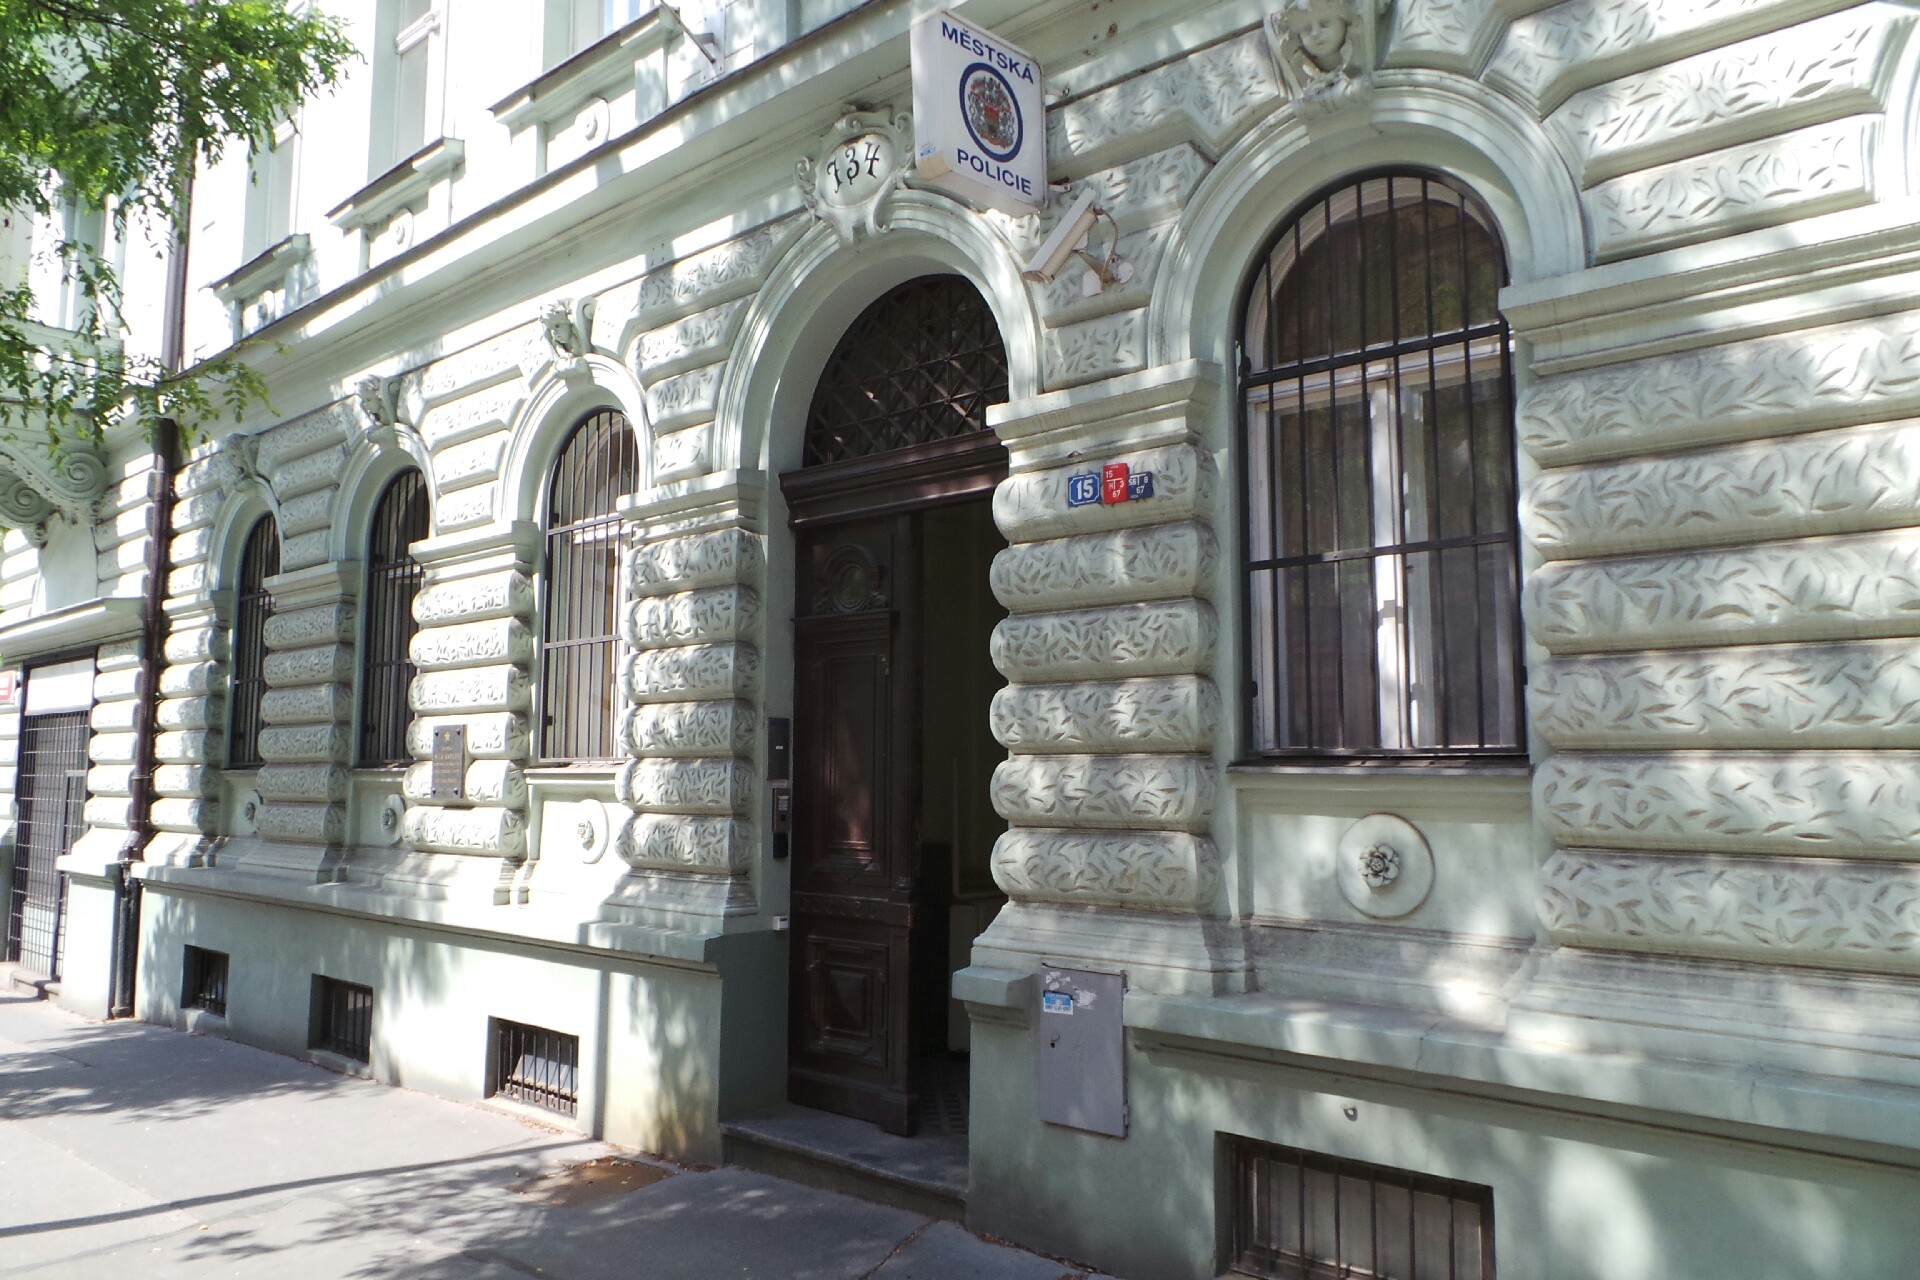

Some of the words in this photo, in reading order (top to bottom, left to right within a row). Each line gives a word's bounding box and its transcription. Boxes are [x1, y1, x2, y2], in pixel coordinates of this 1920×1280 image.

[942, 21, 1034, 84] MĚSTSKÁ
[826, 141, 881, 194] 734
[957, 148, 1032, 196] POLICIE
[1077, 478, 1094, 500] 15
[1105, 470, 1114, 479] 15
